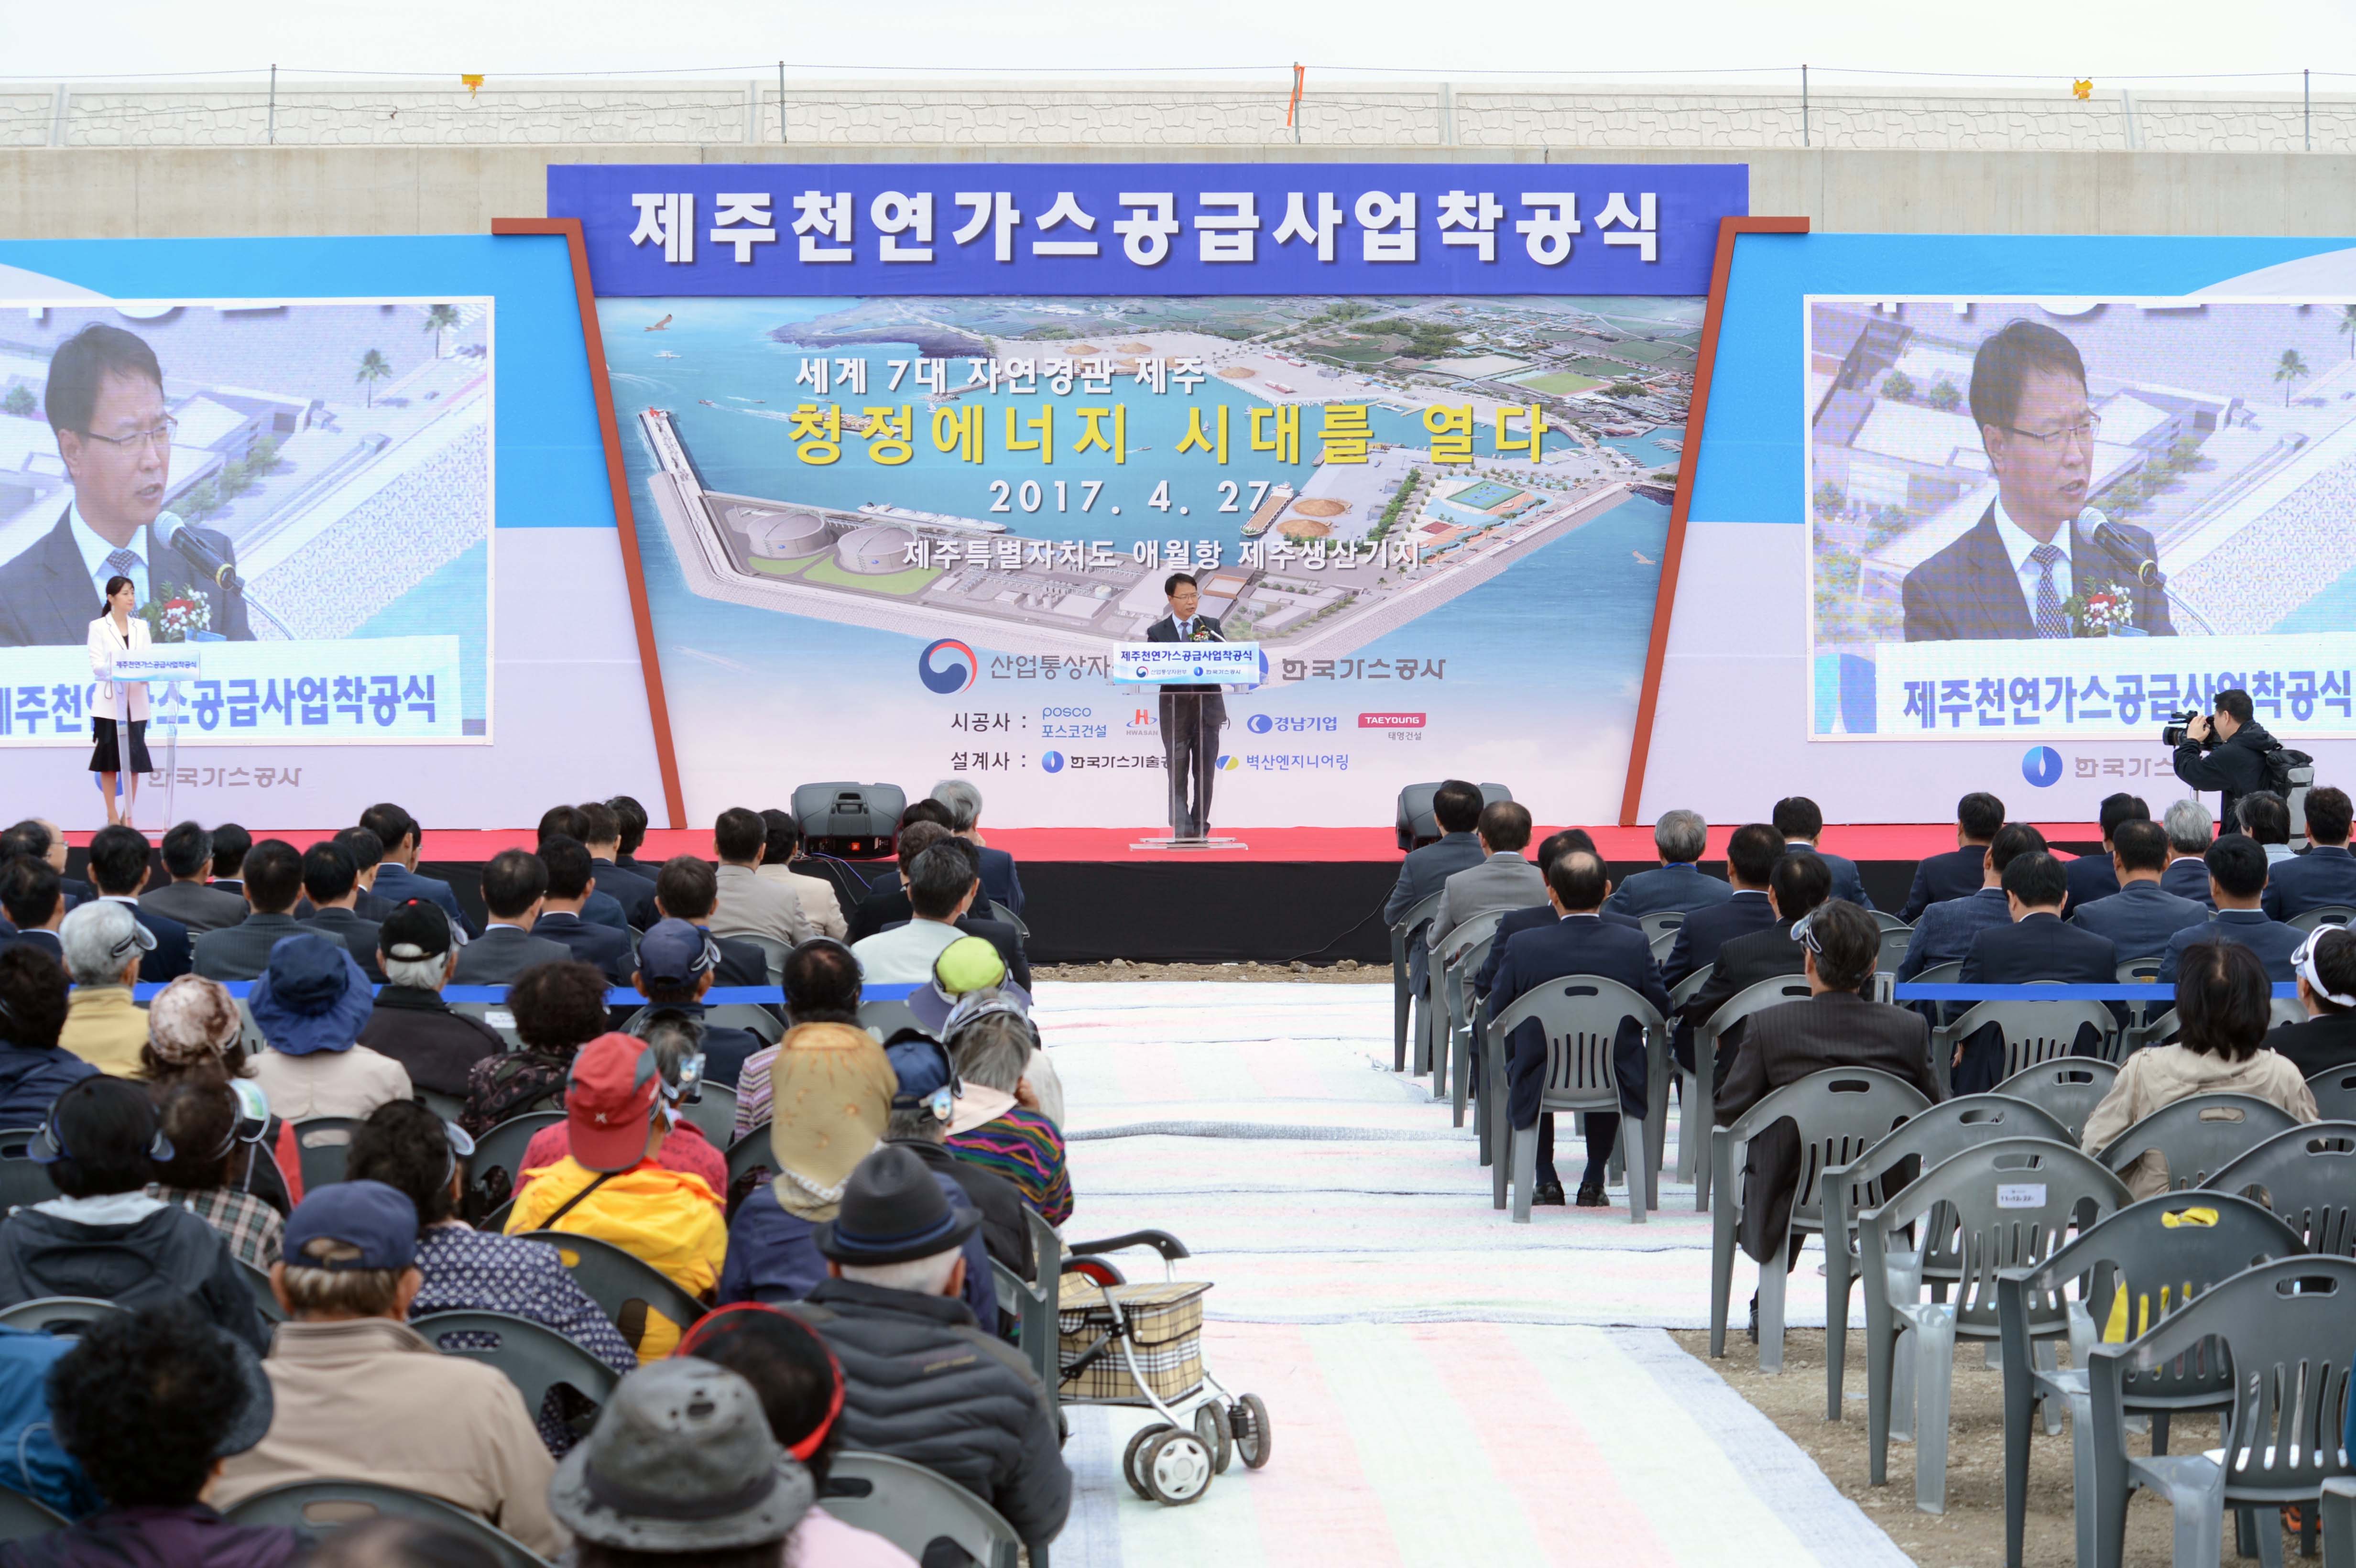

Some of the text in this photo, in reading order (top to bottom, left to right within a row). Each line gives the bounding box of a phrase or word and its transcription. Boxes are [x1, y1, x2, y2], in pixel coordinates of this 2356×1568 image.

[629, 190, 1658, 265] 제주천연가스공급사업착공식
[796, 358, 1204, 395] 세계 7대 자연경관 제주
[789, 404, 1548, 464] 청정에너지 시대를 열다
[989, 480, 1270, 514] 2017. 4. 27
[903, 540, 1418, 570] 제주특별자치도 애월항 제주생산기지
[1121, 651, 1252, 662] 제주천연가스공급사업착공식
[990, 655, 1113, 680] 산업통상자
[1282, 658, 1446, 681] 한국가스공사
[951, 712, 1010, 732] 시공사
[1042, 707, 1091, 720] posco
[1041, 724, 1107, 738] 포스코건설
[1275, 717, 1337, 731] 경남기업
[1388, 731, 1422, 740] 태영건설
[951, 751, 1010, 771] 설계사
[1246, 754, 1349, 771] 벽산엔지니어링
[148, 767, 303, 788] 한국가스공사
